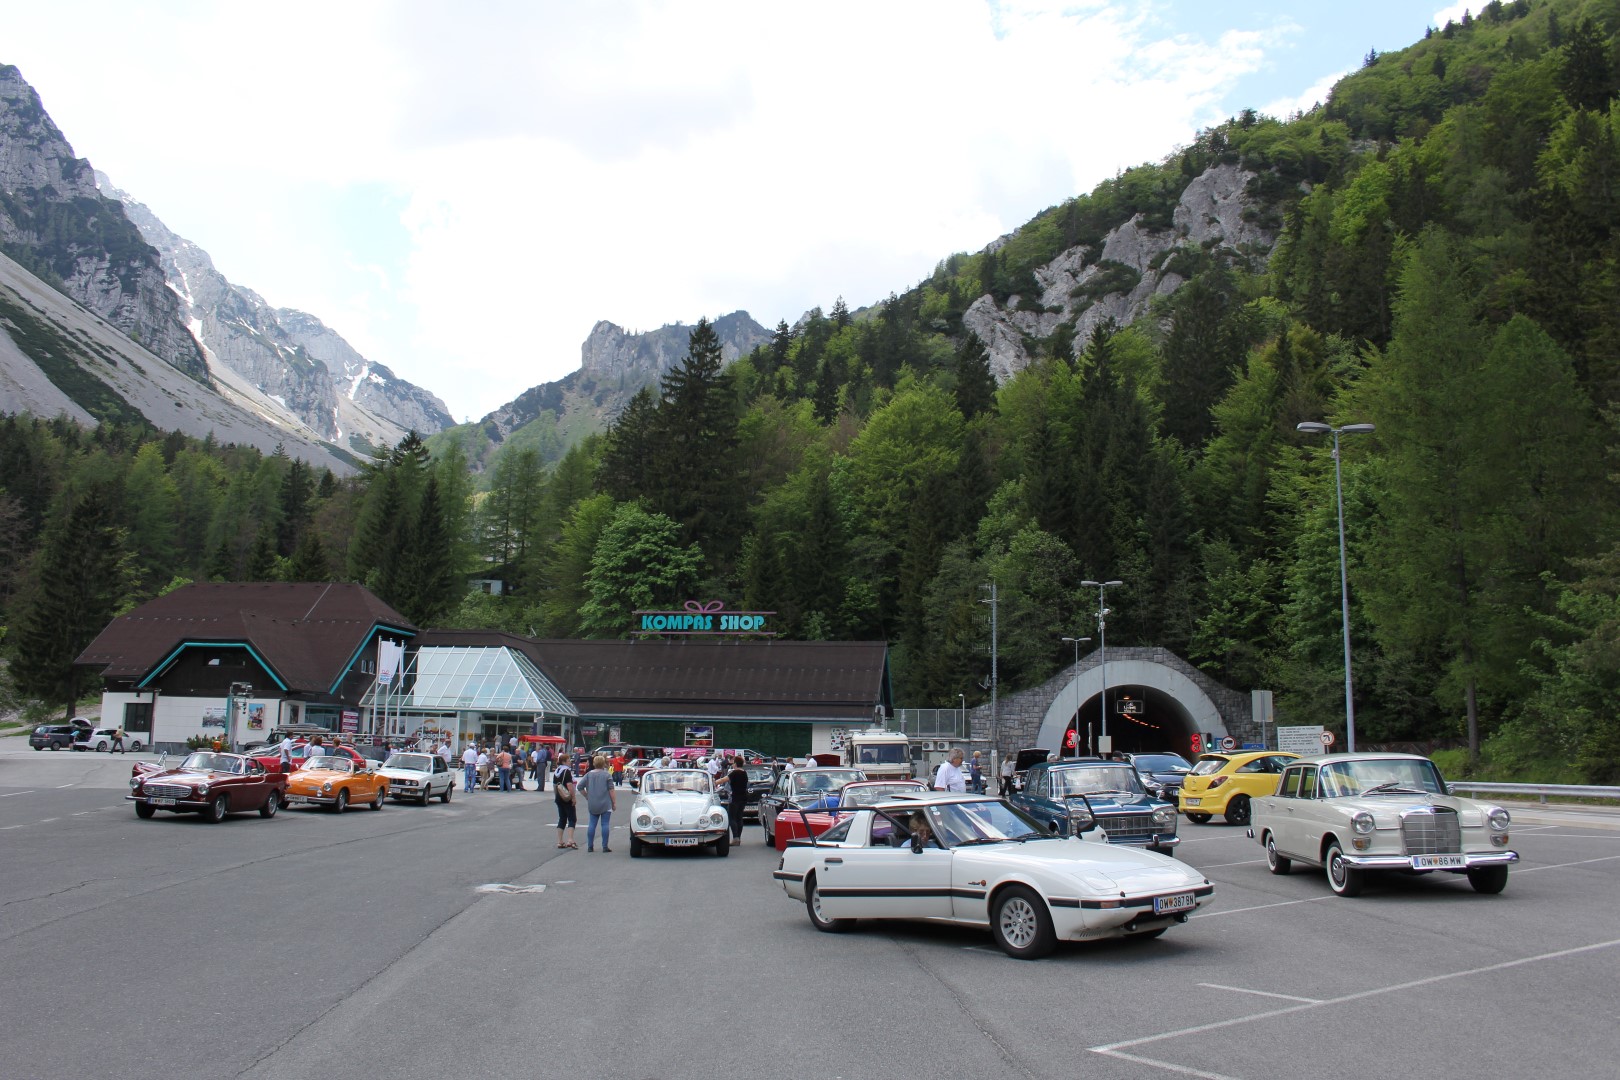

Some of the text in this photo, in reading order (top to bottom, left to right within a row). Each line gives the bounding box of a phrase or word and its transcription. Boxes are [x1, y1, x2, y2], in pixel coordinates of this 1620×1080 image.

[641, 615, 765, 630] KOMPAS SHOP
[1421, 856, 1461, 866] OW 86 MW
[1160, 898, 1169, 909] OW
